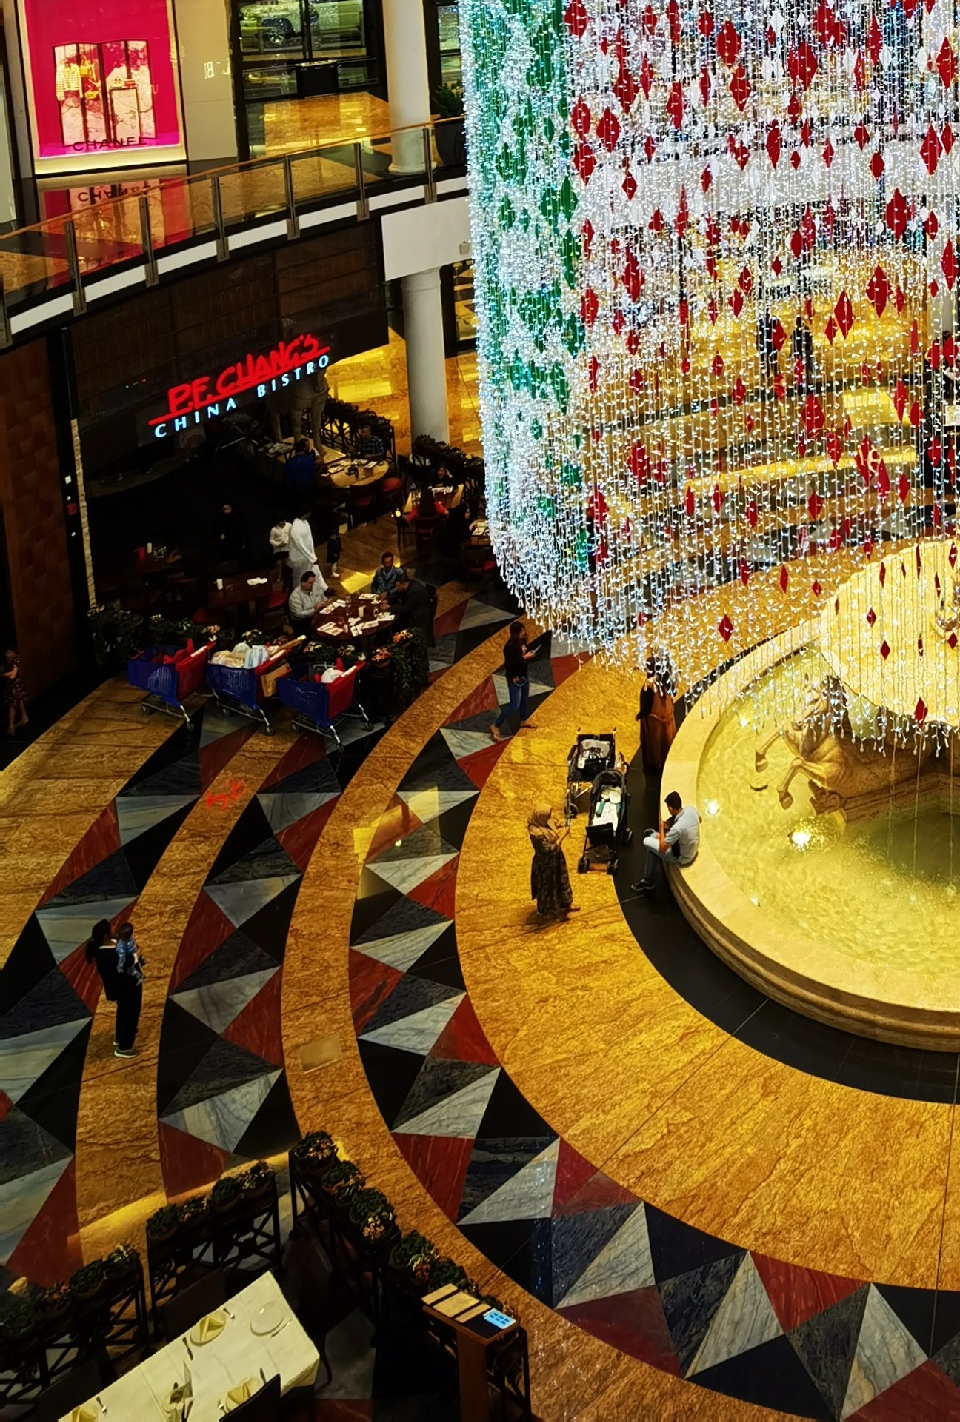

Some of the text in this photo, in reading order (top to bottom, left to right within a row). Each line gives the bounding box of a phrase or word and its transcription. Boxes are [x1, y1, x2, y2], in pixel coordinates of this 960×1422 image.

[72, 136, 148, 152] CHANEL
[154, 354, 330, 438] CHINA BISTRO
